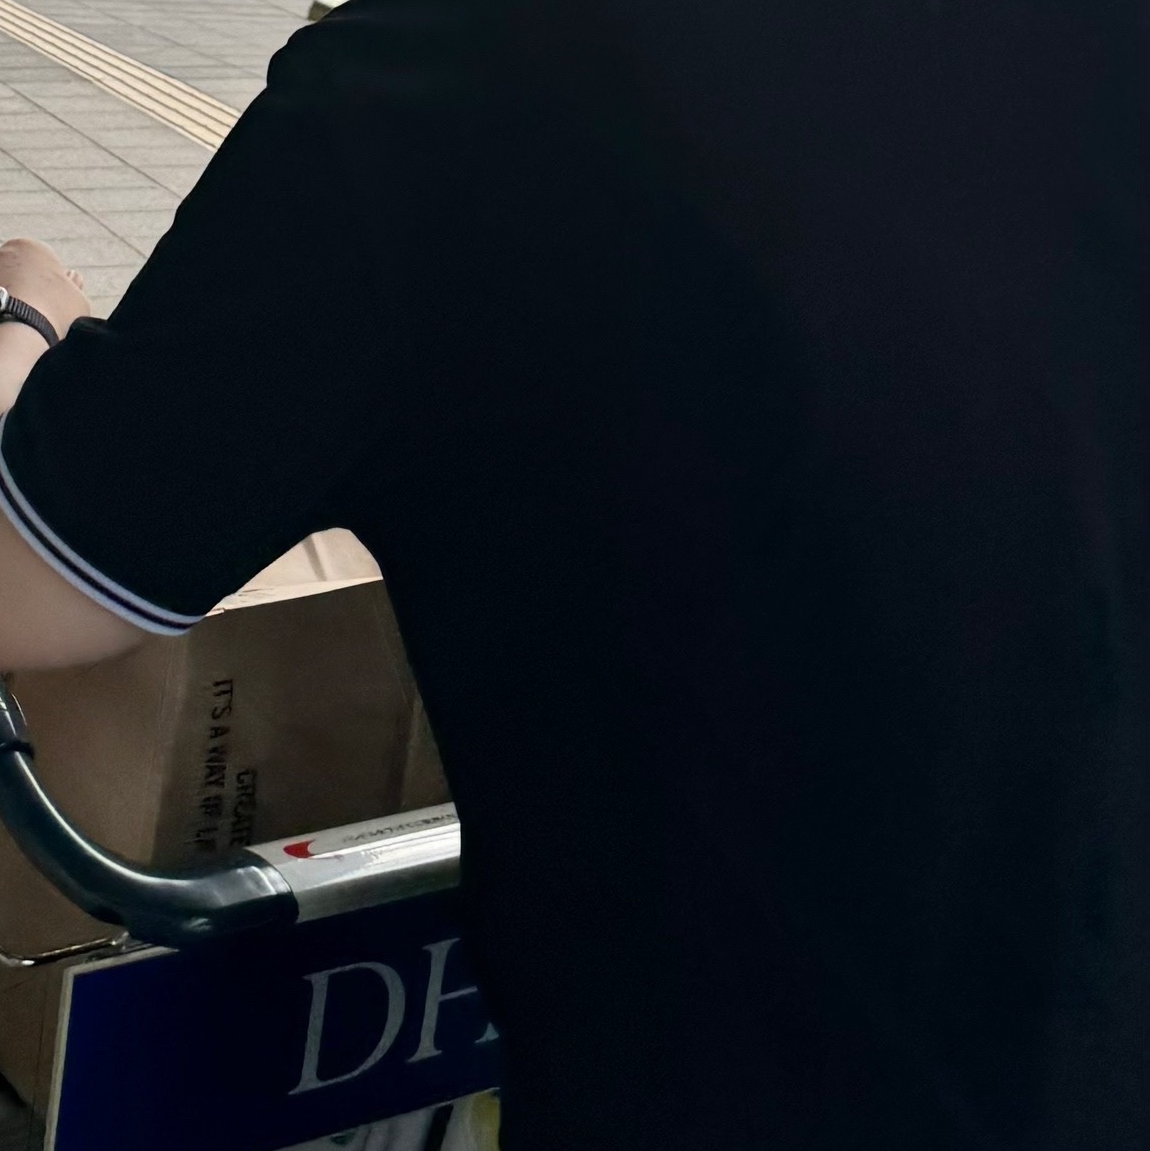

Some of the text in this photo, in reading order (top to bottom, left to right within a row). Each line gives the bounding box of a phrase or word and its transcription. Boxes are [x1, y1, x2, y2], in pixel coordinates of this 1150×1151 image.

[210, 726, 230, 739] A
[205, 745, 227, 789] WAY
[288, 938, 500, 1095] DH
